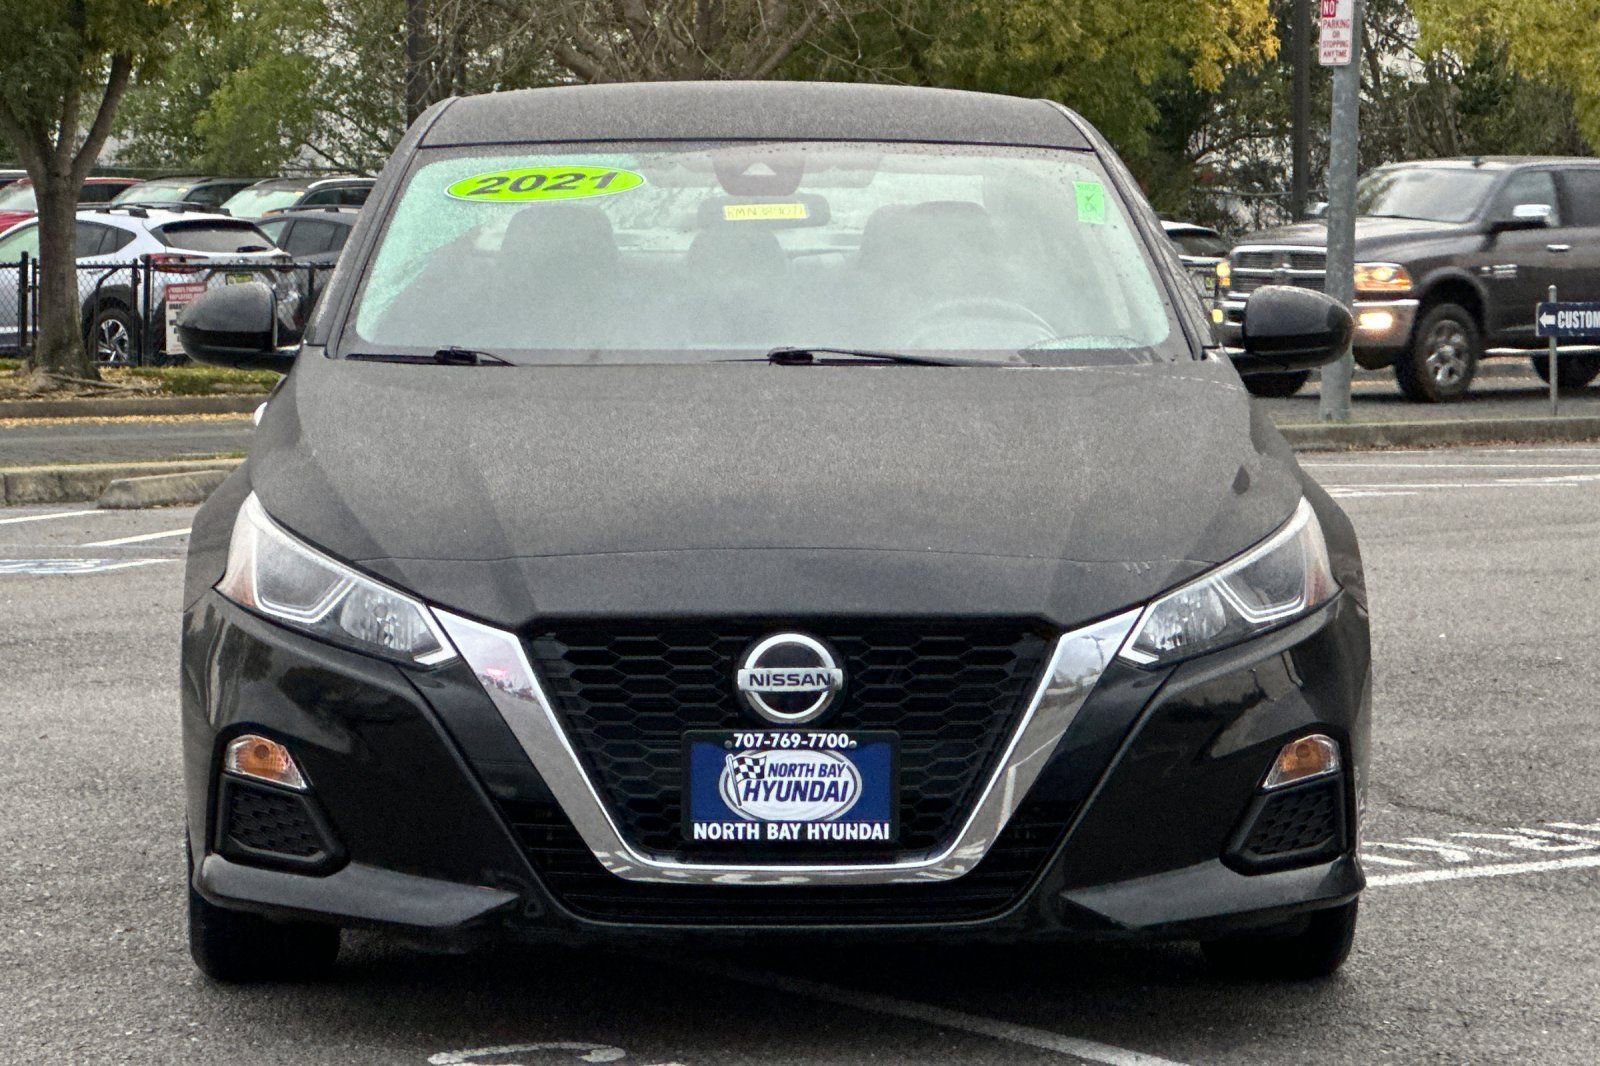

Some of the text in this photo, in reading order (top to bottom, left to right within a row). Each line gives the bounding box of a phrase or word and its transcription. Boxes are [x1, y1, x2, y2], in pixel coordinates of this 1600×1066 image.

[1323, 0, 1335, 16] NO
[1322, 19, 1350, 29] PARKING
[1322, 40, 1349, 48] STOPPING
[466, 171, 618, 197] 2021
[1557, 310, 1600, 329] CUSTOM
[749, 673, 831, 687] NISSAN
[733, 733, 849, 749] 707-769-7700
[768, 763, 845, 778] NORTH BAY
[742, 780, 849, 803] HYUNDAI
[693, 823, 890, 840] NORTH BAY HYUNDAI
